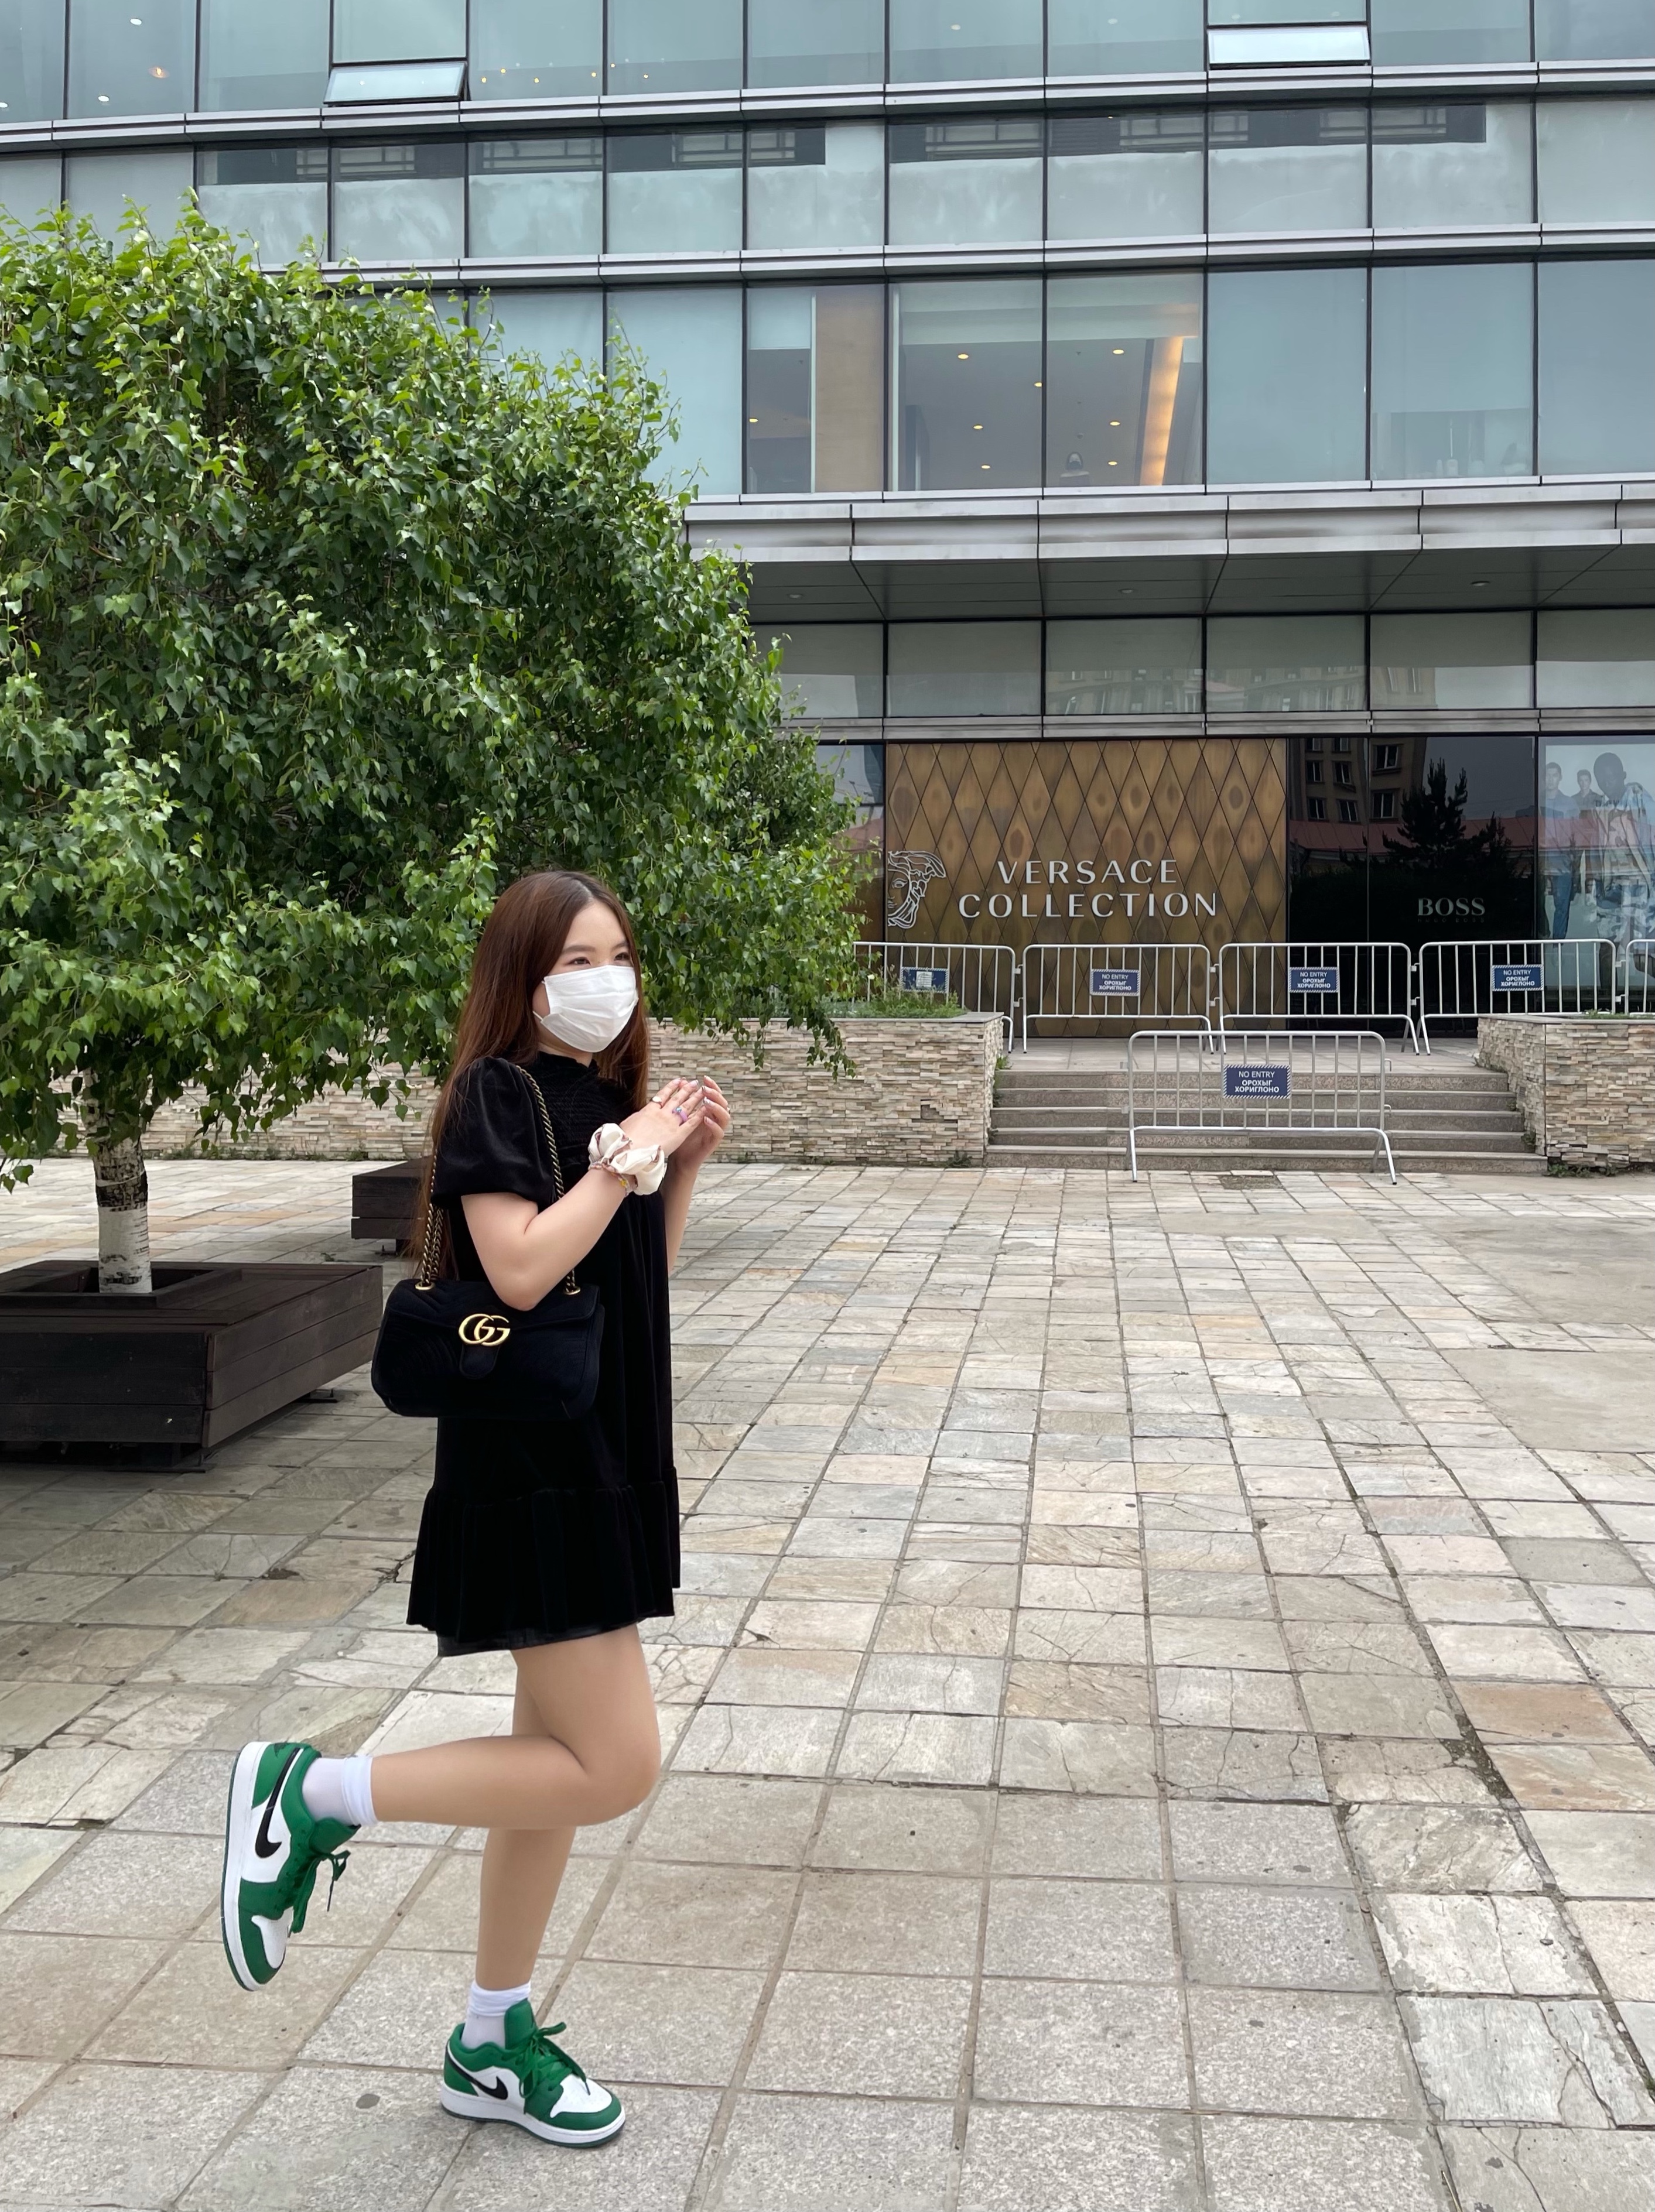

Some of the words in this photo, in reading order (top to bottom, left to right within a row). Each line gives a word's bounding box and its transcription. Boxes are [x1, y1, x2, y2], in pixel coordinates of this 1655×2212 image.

[997, 860, 1177, 885] VERSACE
[959, 893, 1216, 918] COLLECTION
[1417, 898, 1485, 916] BOSS
